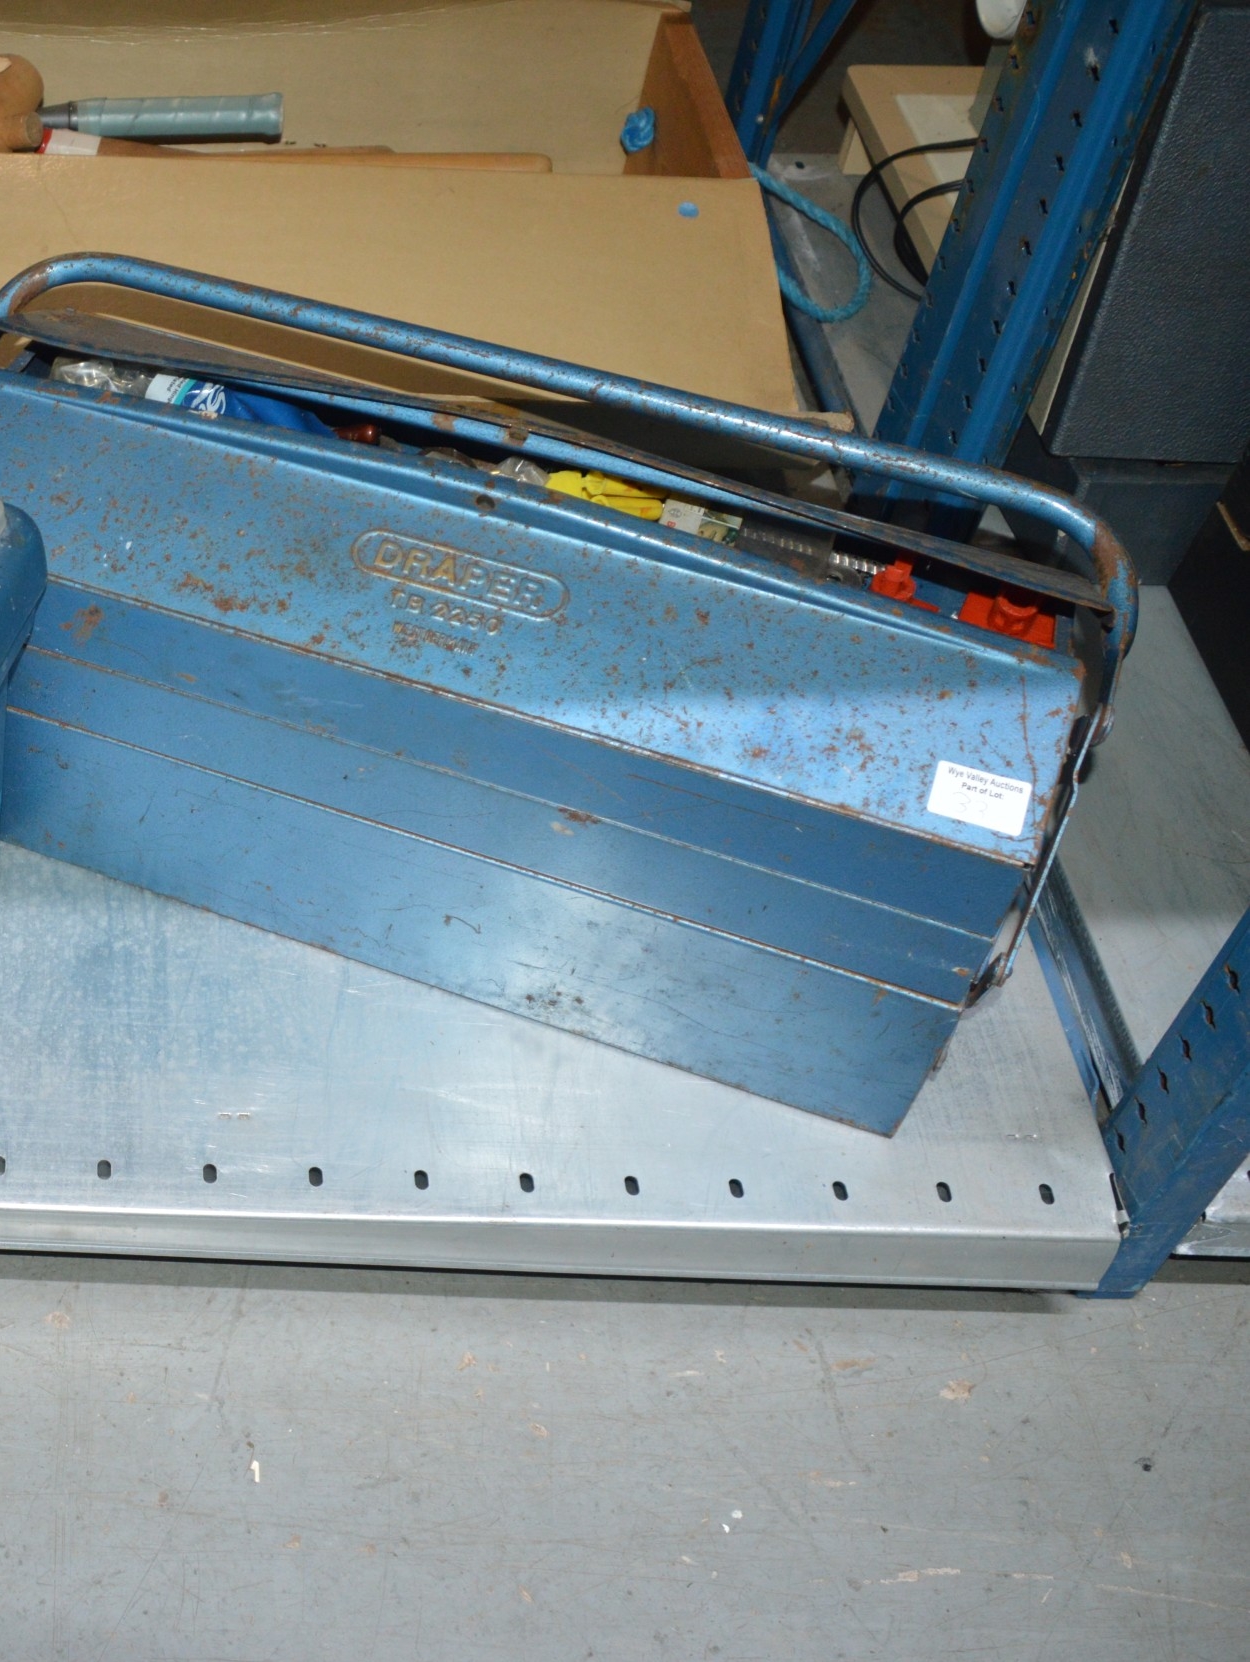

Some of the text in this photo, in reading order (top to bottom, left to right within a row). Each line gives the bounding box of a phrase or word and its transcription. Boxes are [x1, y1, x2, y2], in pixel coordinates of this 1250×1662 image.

[373, 538, 546, 611] DRAPER
[948, 766, 1024, 794] Wye Valley Auctions
[961, 782, 978, 793] Part
[989, 790, 1004, 800] Lot:
